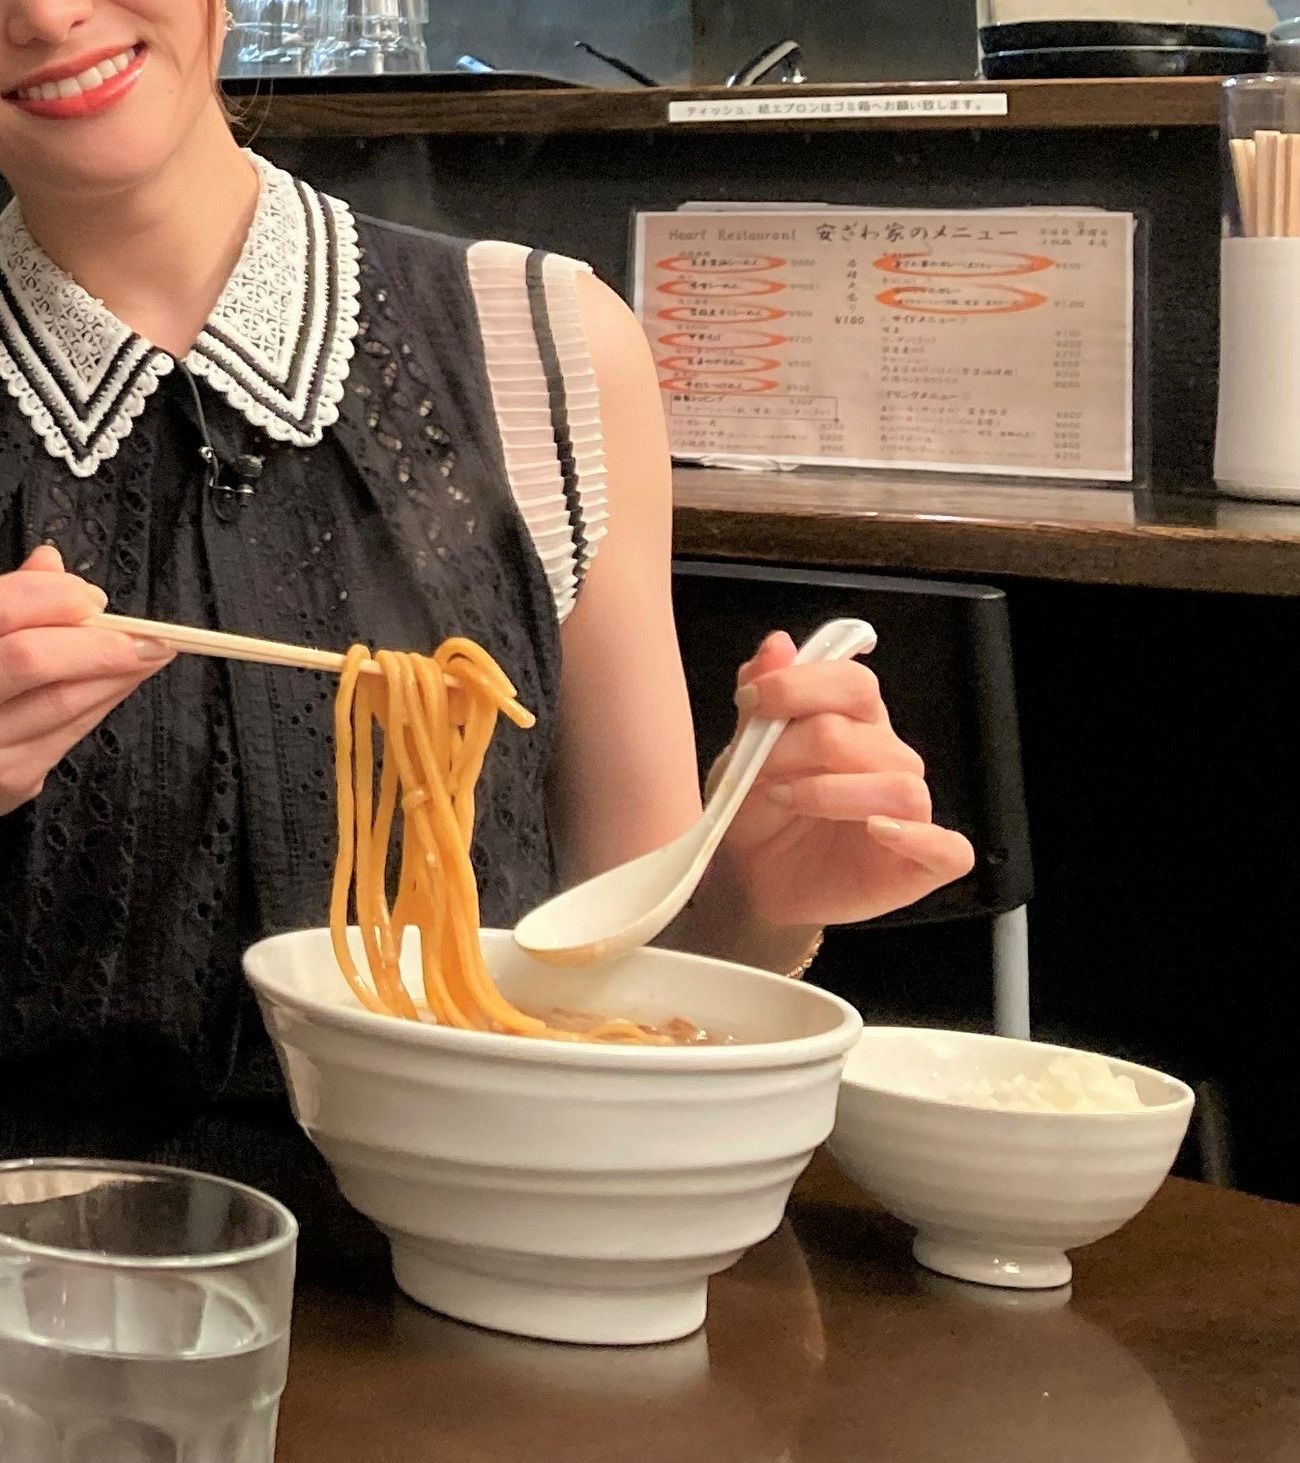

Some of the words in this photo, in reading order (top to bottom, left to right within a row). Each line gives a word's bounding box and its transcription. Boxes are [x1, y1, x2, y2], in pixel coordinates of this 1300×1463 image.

[669, 228, 707, 242] Heart
[717, 228, 797, 242] Restaurant
[815, 221, 1019, 244] 安ざわ家のメニュー
